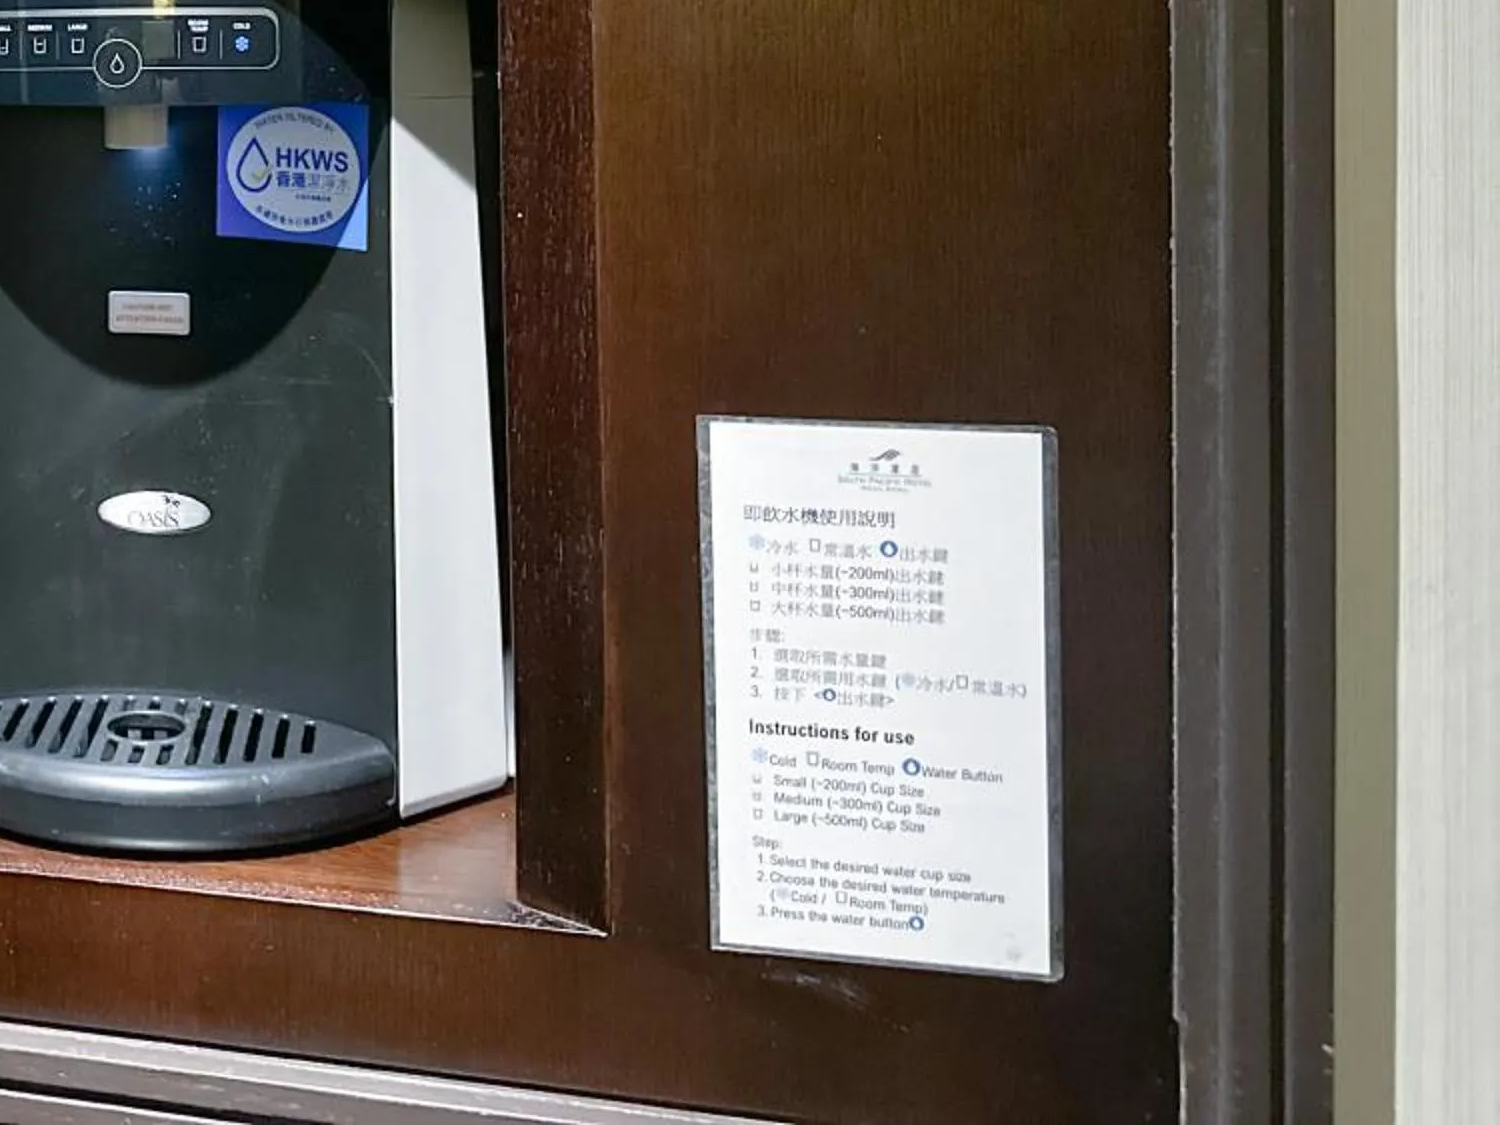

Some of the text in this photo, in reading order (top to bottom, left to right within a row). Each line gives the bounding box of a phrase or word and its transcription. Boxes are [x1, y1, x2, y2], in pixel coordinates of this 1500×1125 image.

[276, 146, 349, 173] HKWS
[127, 507, 181, 527] OASIS
[749, 718, 915, 746] Instructions for use
[769, 754, 1004, 783] Cold Room Temp Water Button
[773, 773, 807, 788] Small
[870, 781, 896, 797] Cup
[899, 784, 925, 797] Size
[773, 792, 823, 807] Medium
[887, 800, 912, 816] Cup
[915, 803, 941, 816] Size
[773, 810, 808, 826] Large
[871, 817, 897, 832] Cup
[900, 820, 926, 834] Size
[770, 854, 807, 868] Select
[810, 858, 831, 871] the
[833, 860, 880, 875] desired
[882, 865, 916, 878] water
[920, 869, 945, 883] cup
[770, 871, 815, 887] Choose
[819, 876, 839, 889] the
[842, 879, 887, 894] desired
[891, 884, 926, 897] water
[929, 886, 1006, 905] temperature
[849, 895, 886, 910] Room
[770, 906, 806, 921] Press
[808, 909, 829, 923] the
[831, 913, 866, 926] water
[869, 916, 910, 931] button
